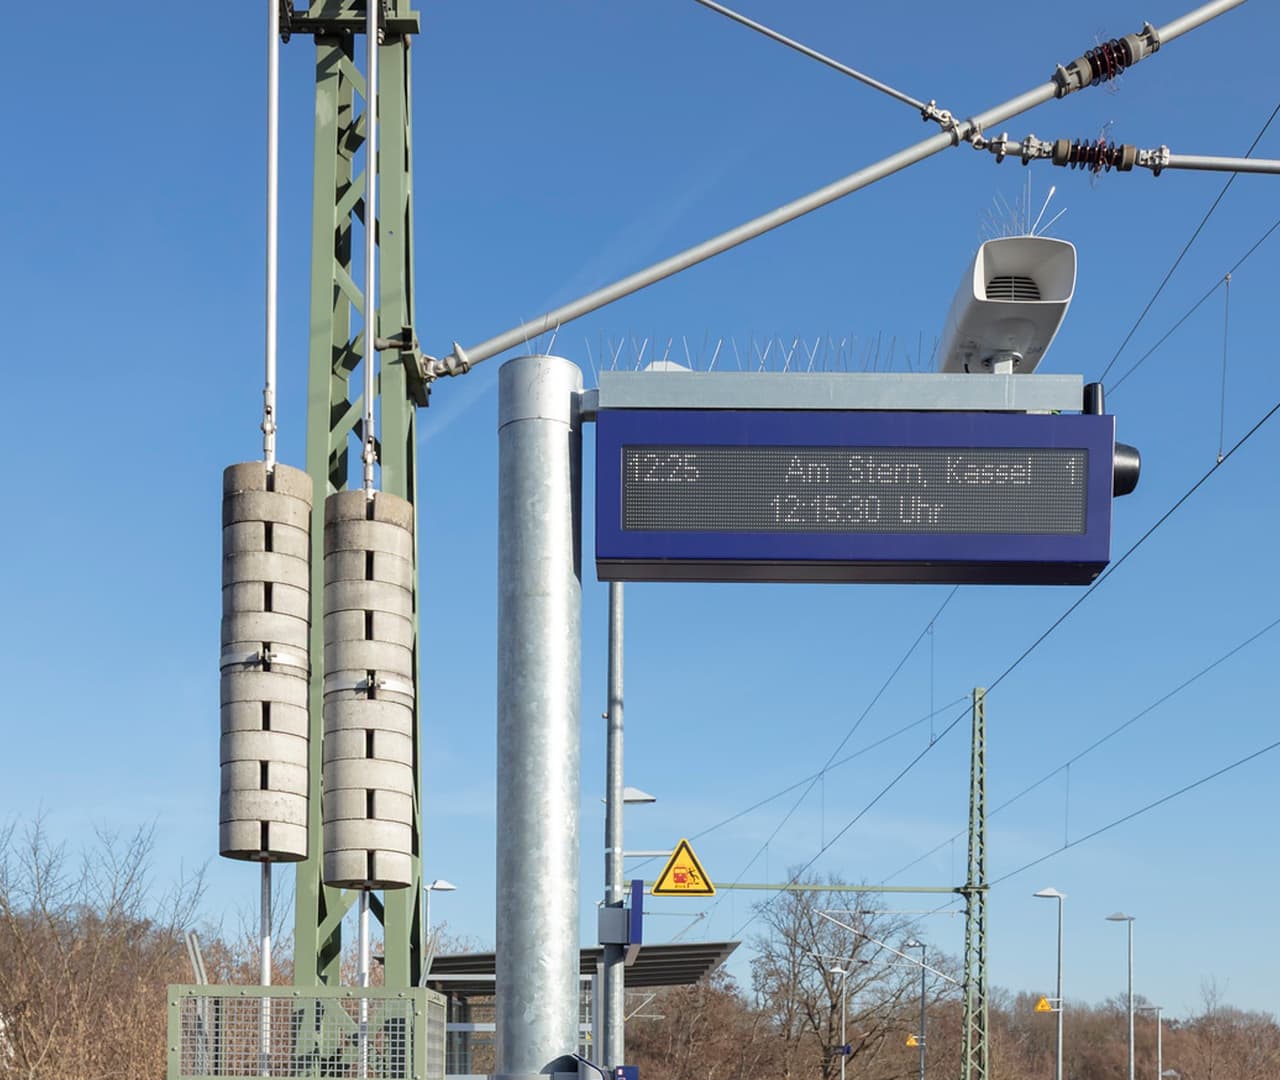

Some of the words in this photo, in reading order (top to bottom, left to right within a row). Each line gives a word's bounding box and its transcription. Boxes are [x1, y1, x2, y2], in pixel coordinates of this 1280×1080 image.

[629, 453, 700, 482] 12:25
[784, 455, 829, 482] Am
[848, 455, 927, 488] Stern,
[946, 456, 1032, 484] Kassel
[1065, 457, 1075, 484] 1
[770, 494, 881, 523] 12:15:30
[899, 495, 945, 524] Uhr
